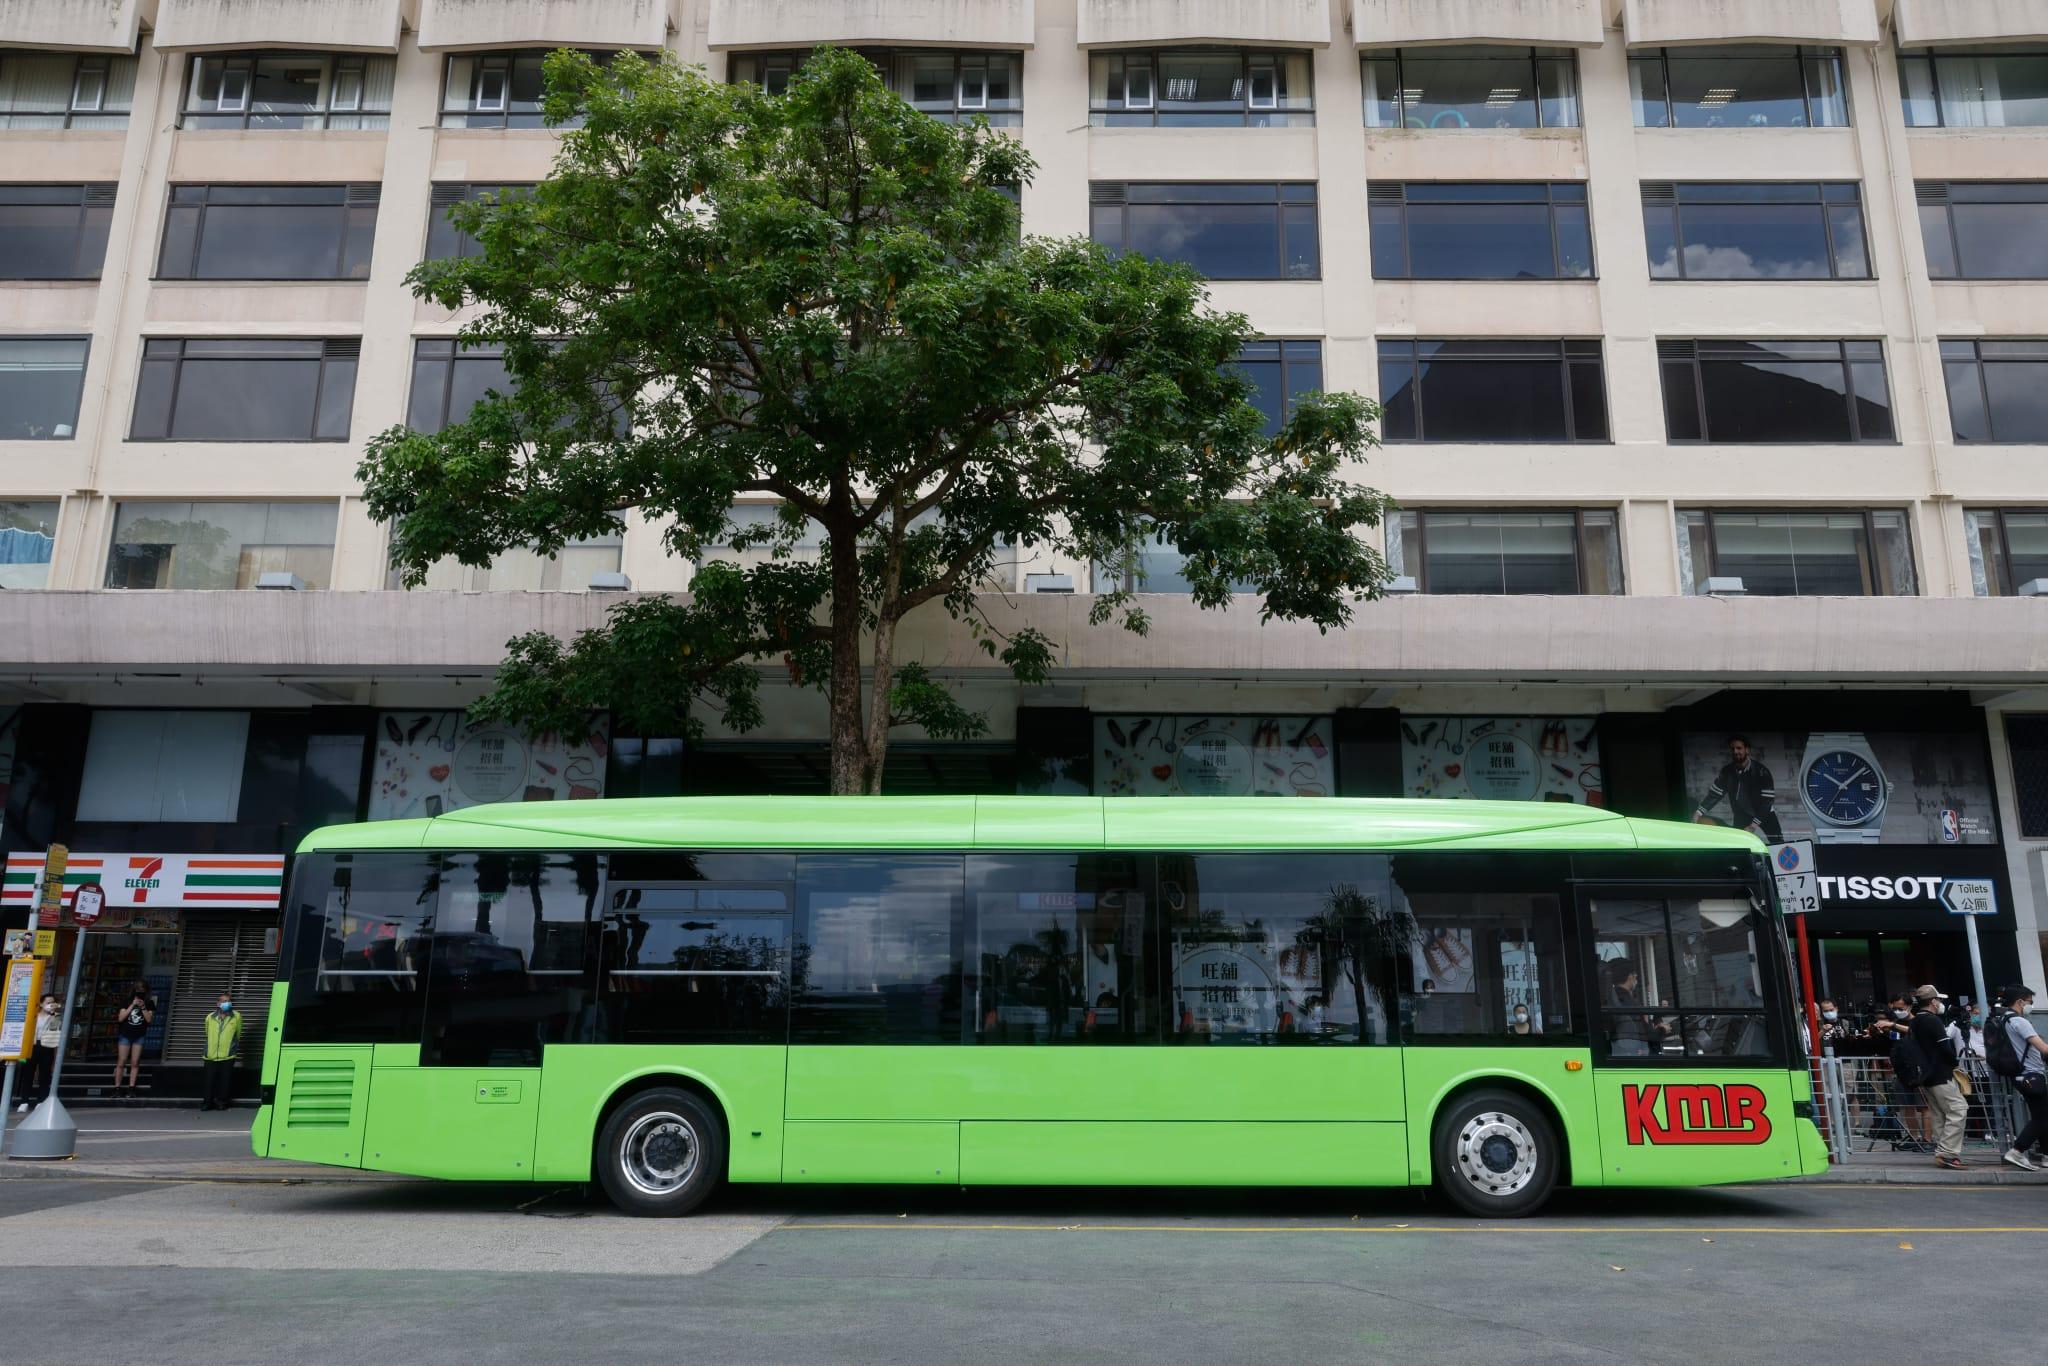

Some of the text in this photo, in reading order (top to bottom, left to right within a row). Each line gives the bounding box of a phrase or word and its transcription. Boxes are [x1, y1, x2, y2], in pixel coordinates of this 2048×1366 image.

[124, 878, 160, 888] ELEVEN
[1796, 875, 1805, 889] 7
[1817, 876, 1942, 900] TISSOT
[1957, 883, 1988, 894] Toilets
[1800, 896, 1816, 910] 12
[1621, 1084, 1772, 1145] KMB
